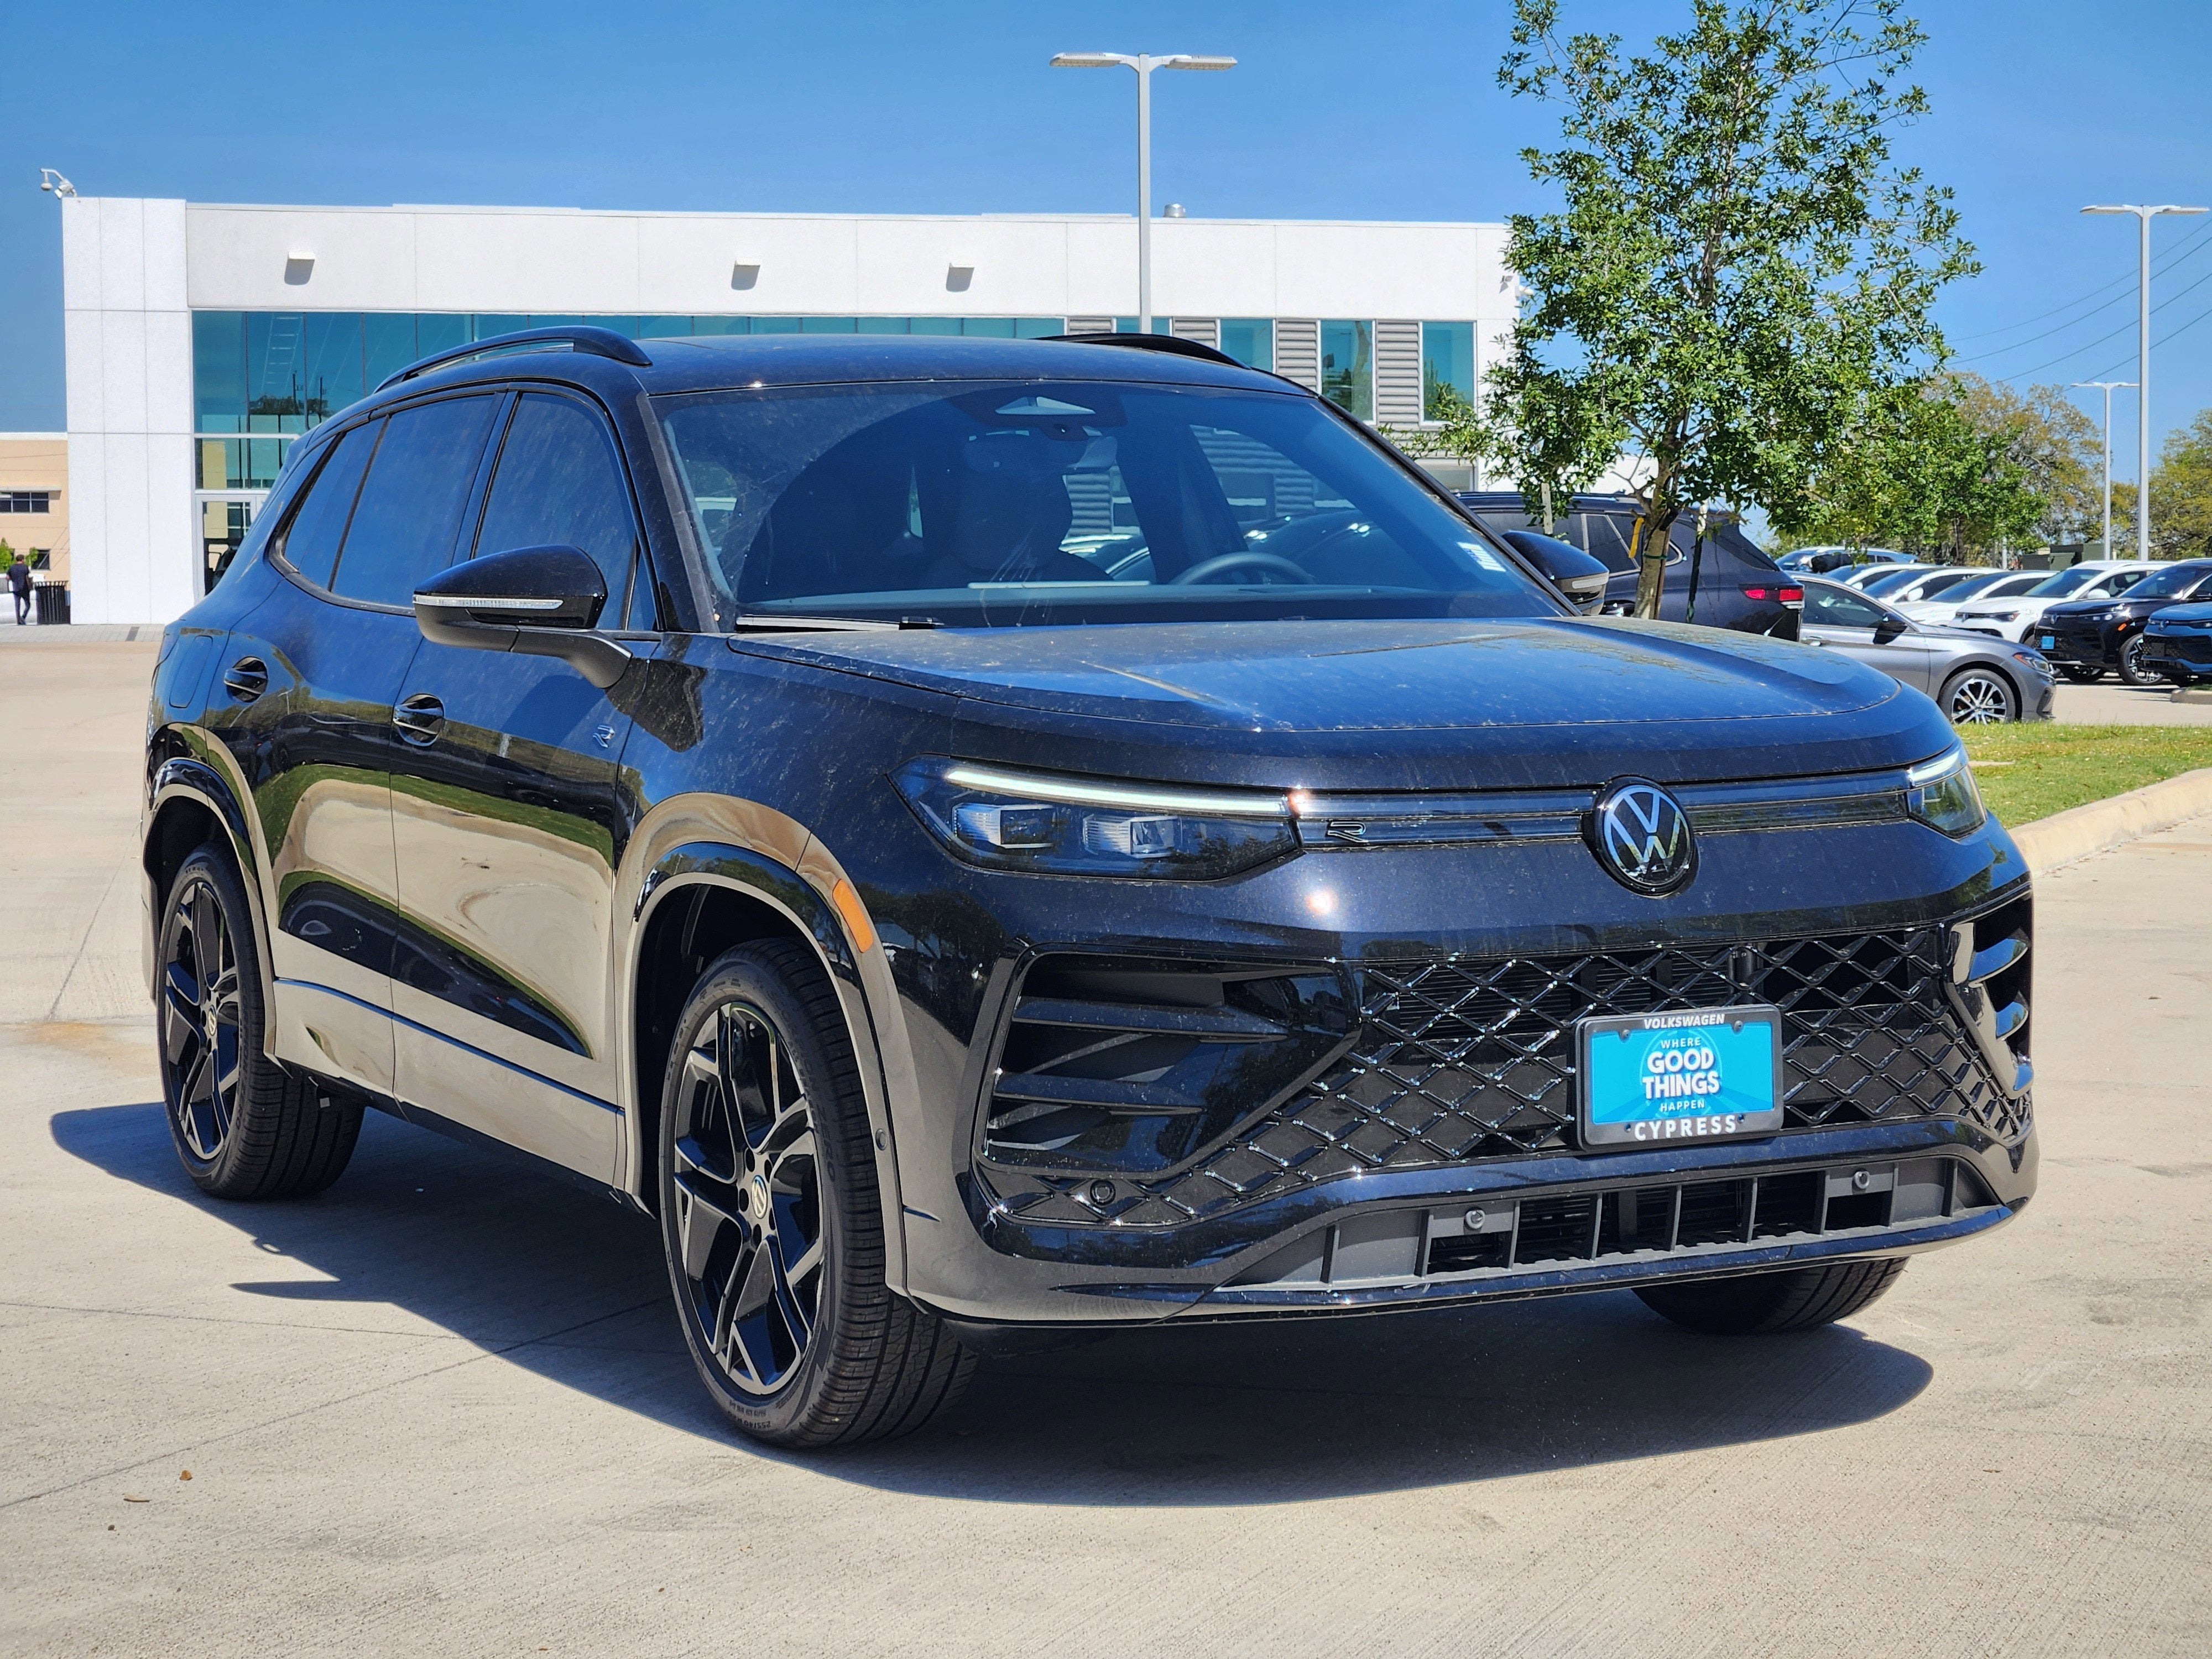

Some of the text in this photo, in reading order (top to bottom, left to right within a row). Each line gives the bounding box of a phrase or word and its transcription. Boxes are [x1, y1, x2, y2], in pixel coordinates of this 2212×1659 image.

[1644, 1014, 1725, 1030] VOLKSWAGEN
[1660, 1037, 1702, 1049] WHERE
[1647, 1047, 1715, 1074] GOOD
[1642, 1071, 1721, 1099] THINGS
[1660, 1099, 1705, 1112] HAPPEN
[1634, 1114, 1737, 1141] CYPRESS
